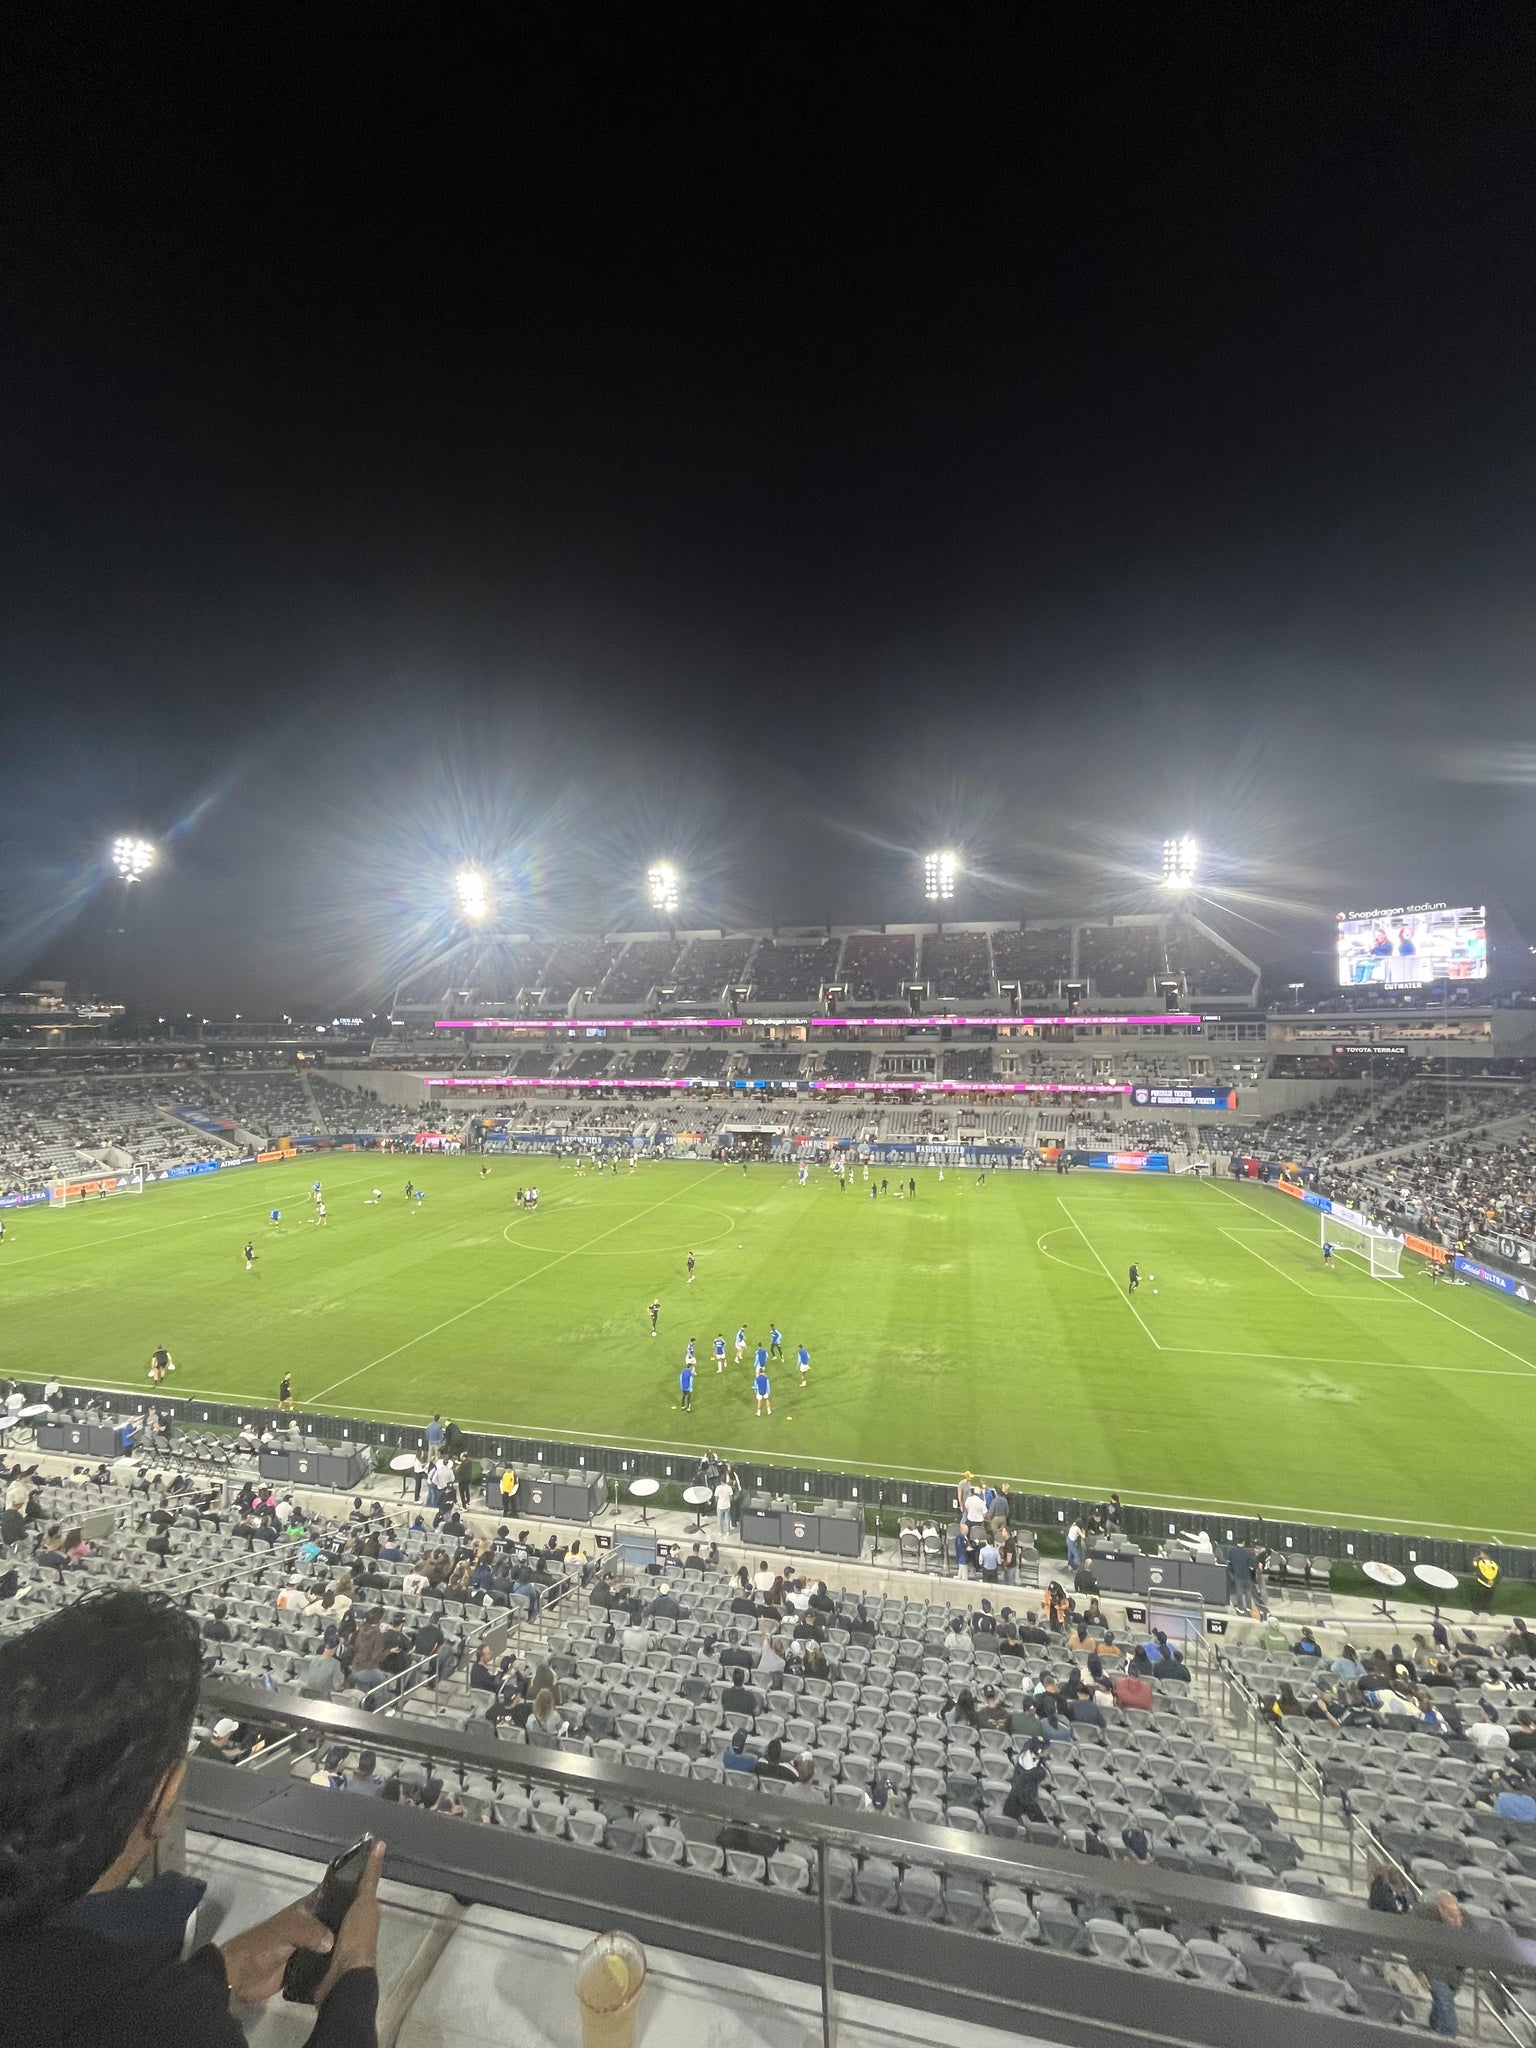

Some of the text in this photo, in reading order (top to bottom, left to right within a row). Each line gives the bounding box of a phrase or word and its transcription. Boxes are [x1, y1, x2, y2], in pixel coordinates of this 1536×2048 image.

[1348, 901, 1447, 920] Snapdragon stadium
[1384, 982, 1422, 990] CUTWATER
[753, 1018, 786, 1026] Snapdragon
[1484, 1271, 1506, 1288] ULTRA
